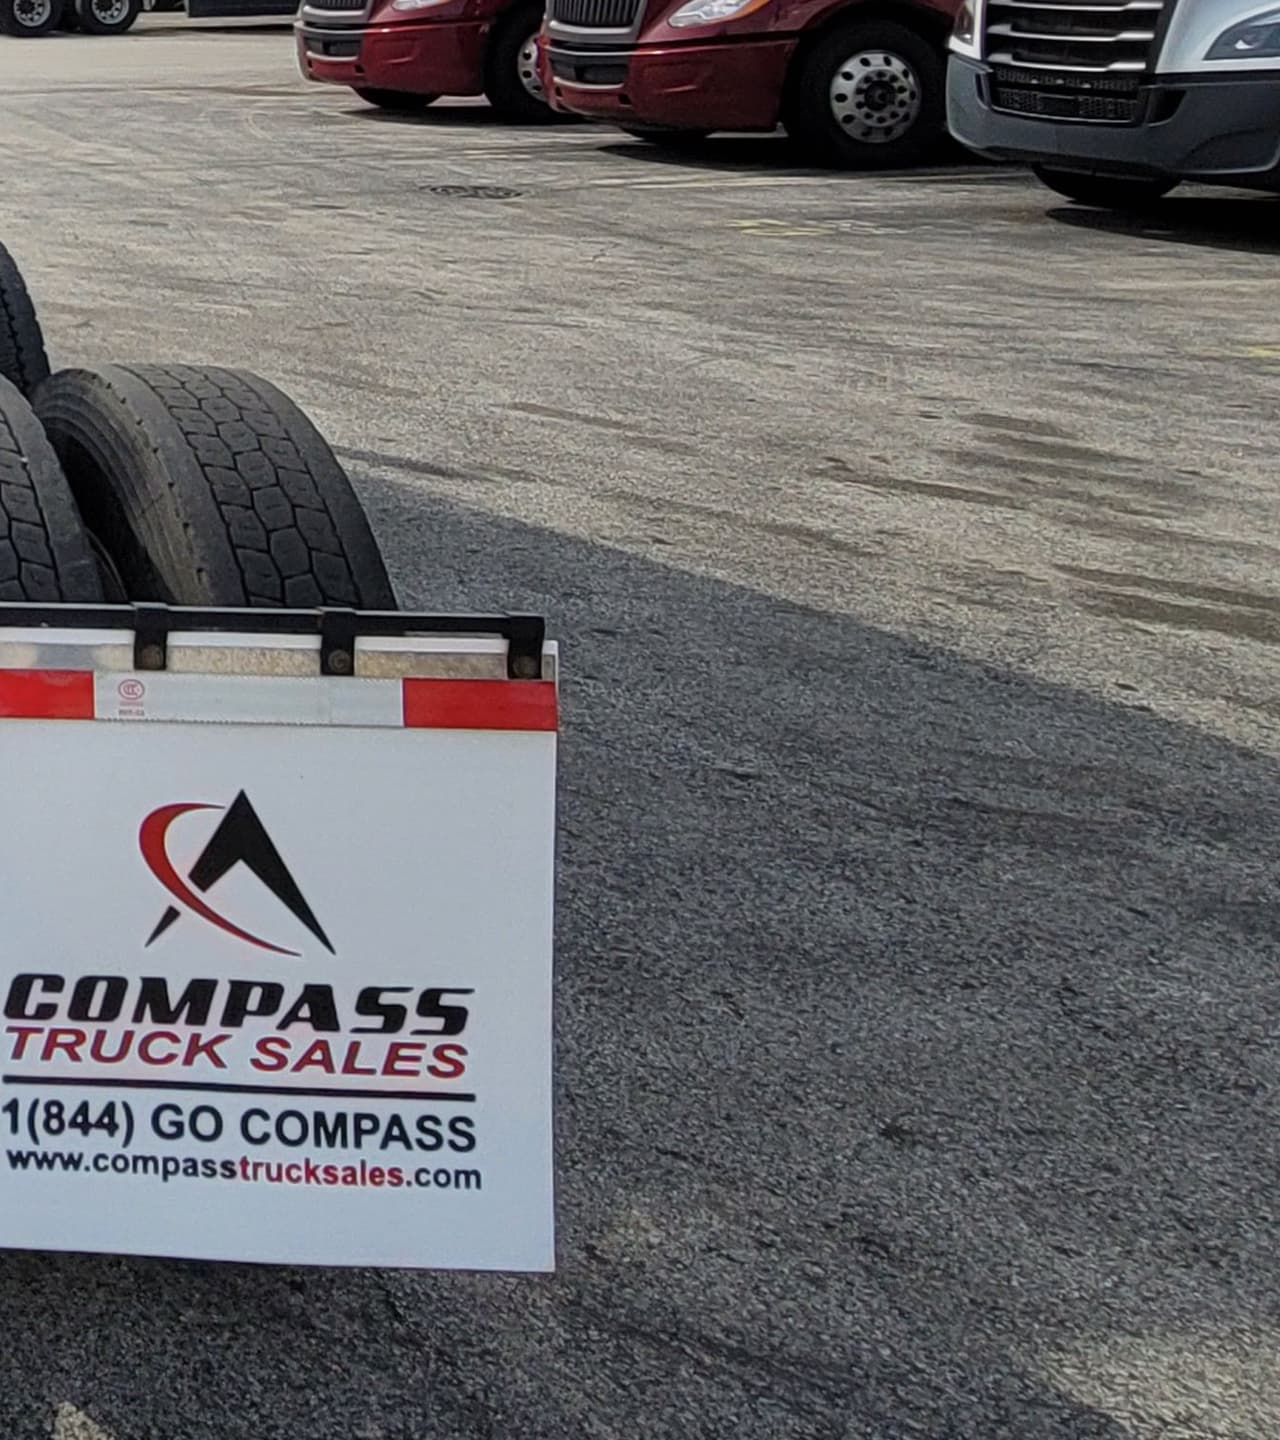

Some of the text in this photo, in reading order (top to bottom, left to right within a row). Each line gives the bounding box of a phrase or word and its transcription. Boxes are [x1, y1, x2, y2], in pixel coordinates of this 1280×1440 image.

[3, 973, 475, 1037] COMPASS
[6, 1026, 468, 1079] TRUCK SALES
[1, 1097, 477, 1153] 1(844) GO COMPASS
[6, 1149, 482, 1190] www.compasstrucksales.com
